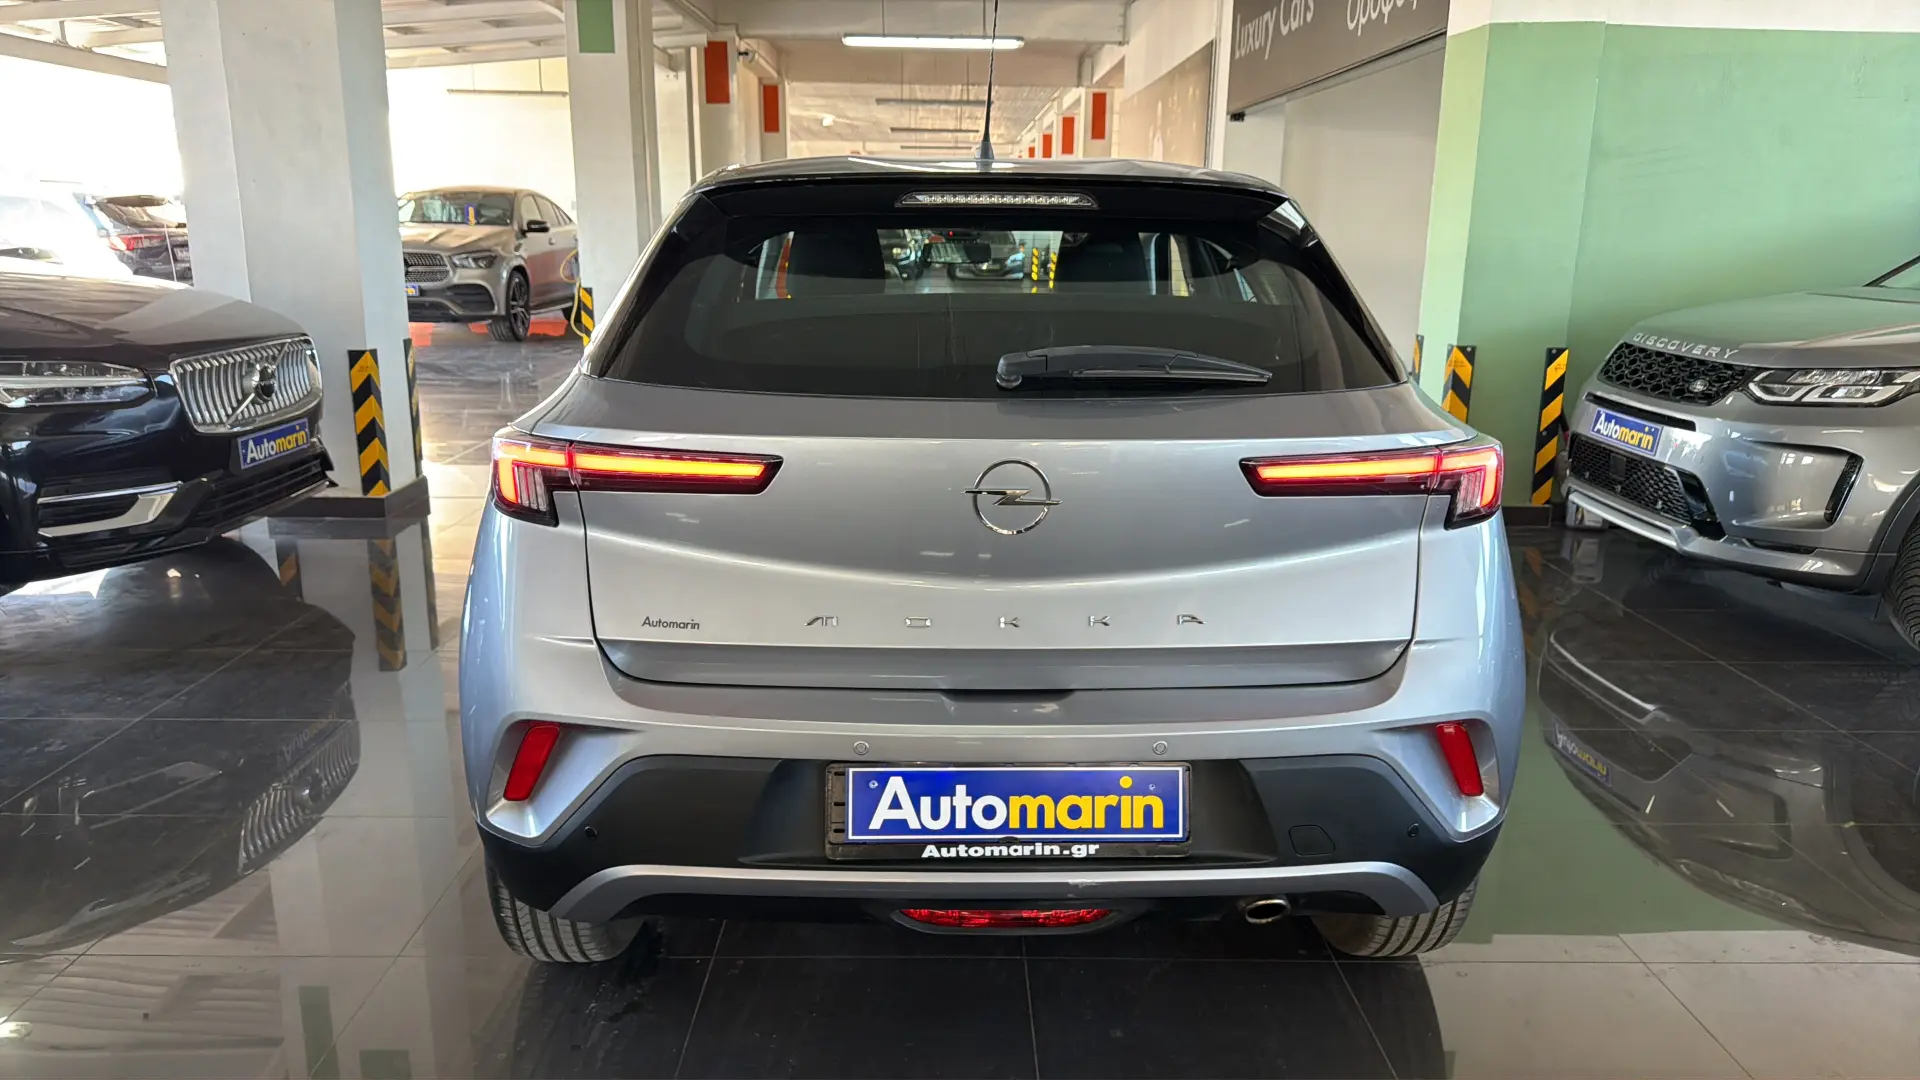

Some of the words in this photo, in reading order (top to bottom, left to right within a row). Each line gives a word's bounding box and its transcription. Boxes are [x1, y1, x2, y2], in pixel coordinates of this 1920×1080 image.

[1235, 6, 1277, 60] Luxury
[1280, 0, 1315, 36] Cars
[1633, 332, 1739, 359] DISCOVERY
[246, 425, 307, 464] Automarin
[1593, 413, 1654, 451] Automarin
[641, 616, 700, 630] Automarin
[868, 776, 1164, 830] Automarin
[921, 843, 1099, 858] Automarin.gr
